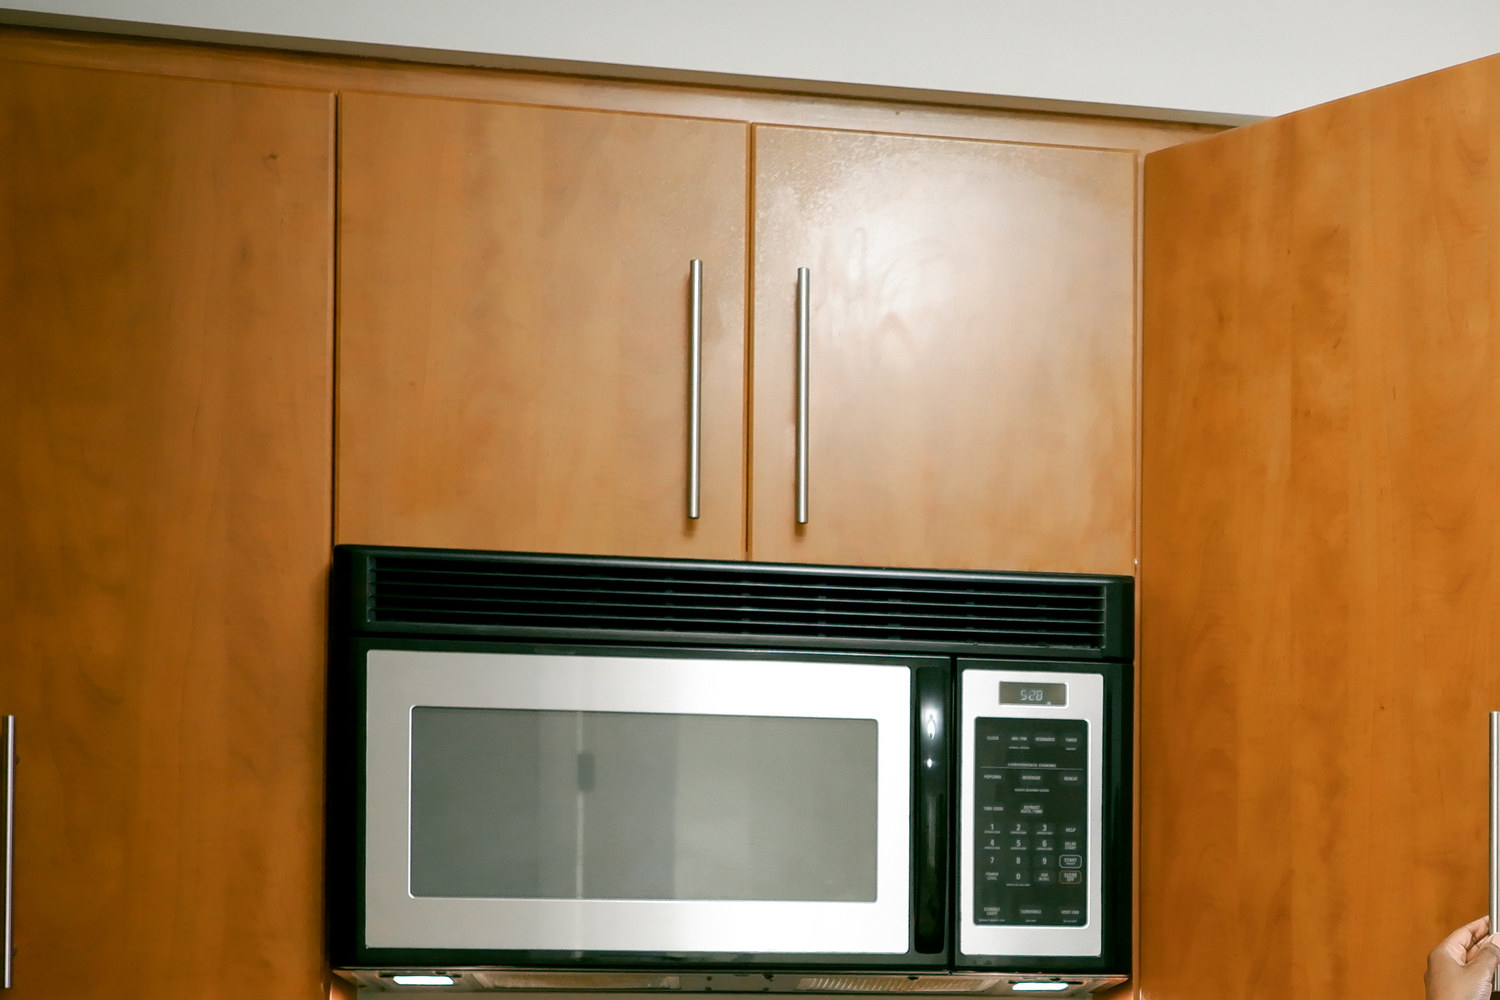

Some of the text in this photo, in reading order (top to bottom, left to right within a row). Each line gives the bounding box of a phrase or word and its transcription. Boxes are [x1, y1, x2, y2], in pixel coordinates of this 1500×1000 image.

[1016, 824, 1022, 832] 2
[1042, 824, 1048, 832] 3
[990, 839, 996, 847] 4
[1042, 840, 1048, 848] 6
[1016, 857, 1022, 865] 8
[1042, 857, 1048, 865] 9
[1016, 873, 1022, 881] 0
